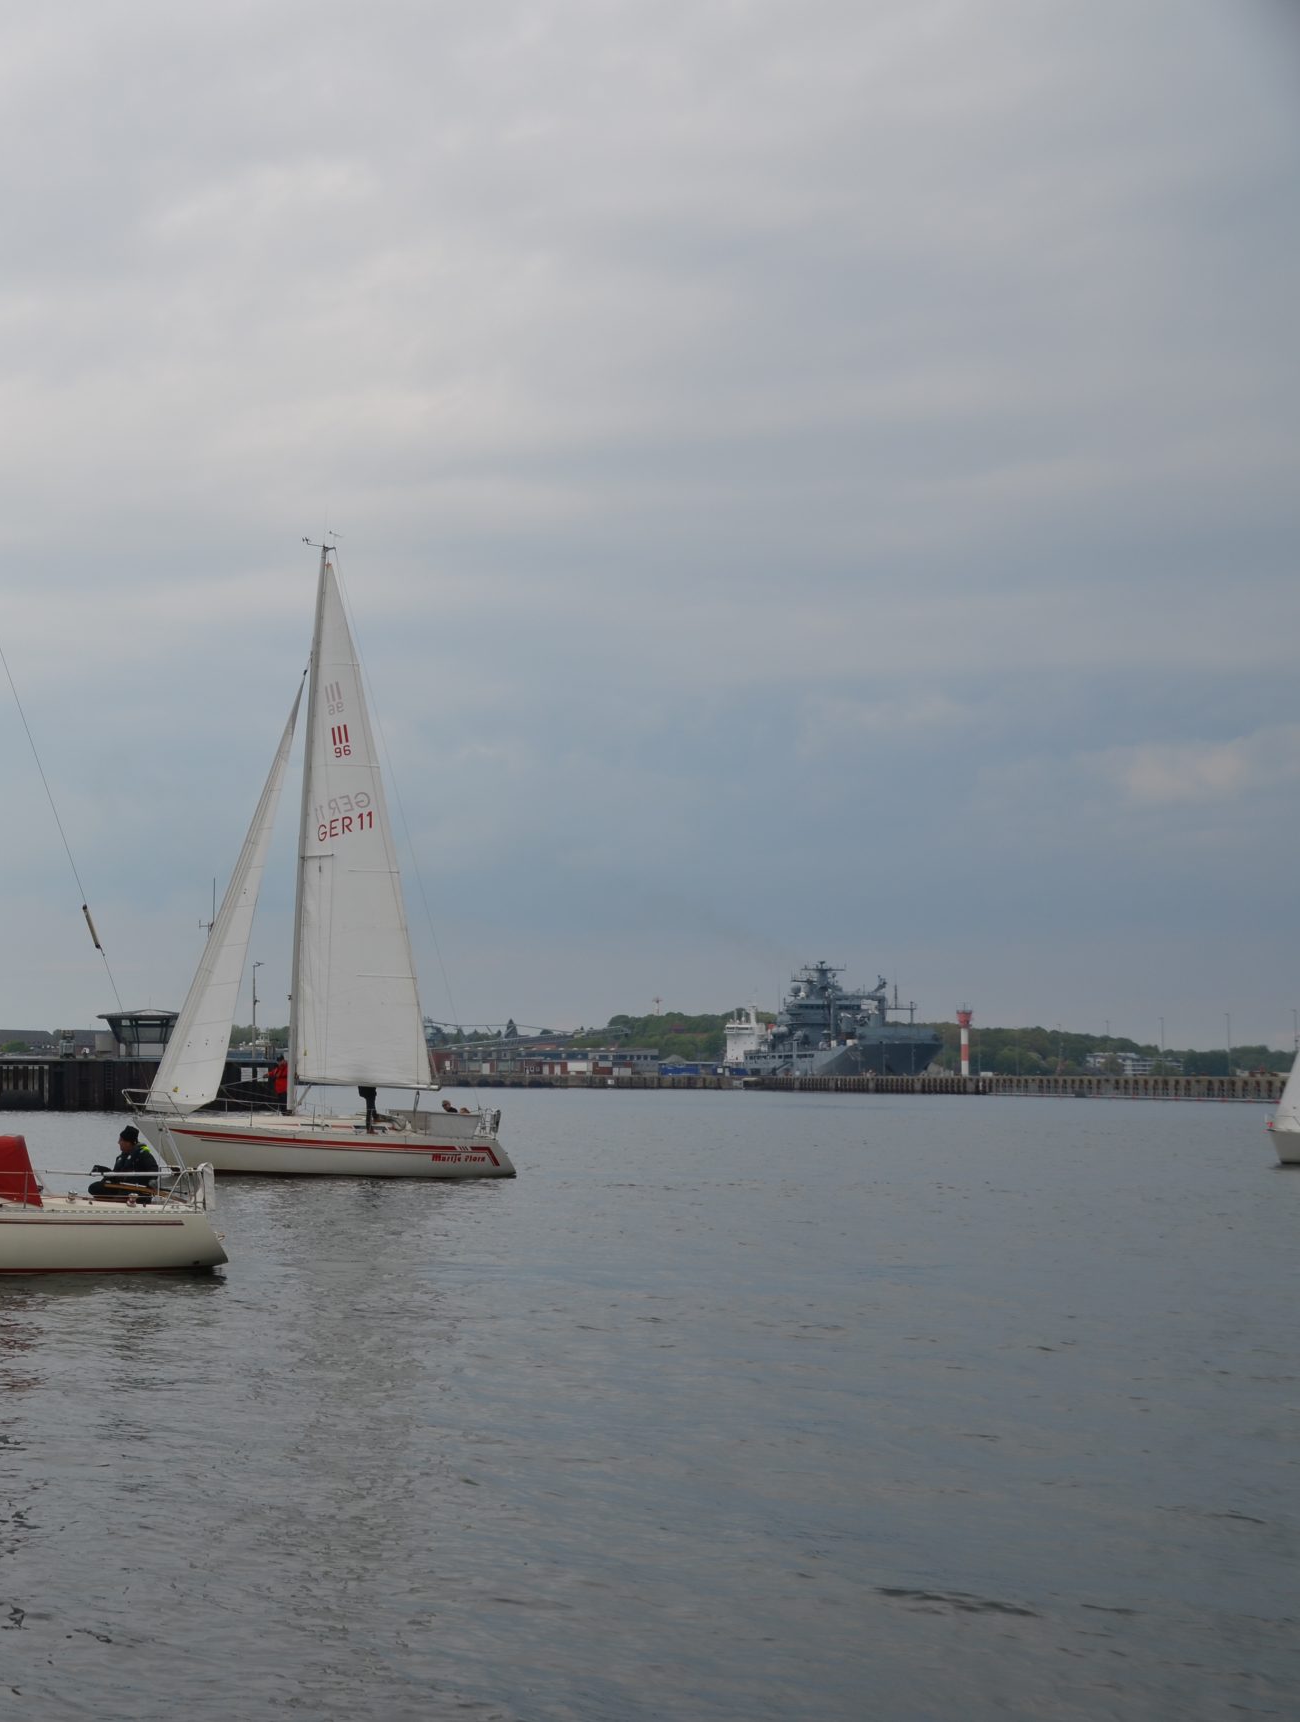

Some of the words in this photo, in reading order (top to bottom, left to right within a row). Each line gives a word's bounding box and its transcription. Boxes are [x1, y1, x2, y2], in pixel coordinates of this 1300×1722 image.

[334, 745, 352, 758] 96
[317, 816, 353, 842] GER
[357, 811, 374, 830] 11
